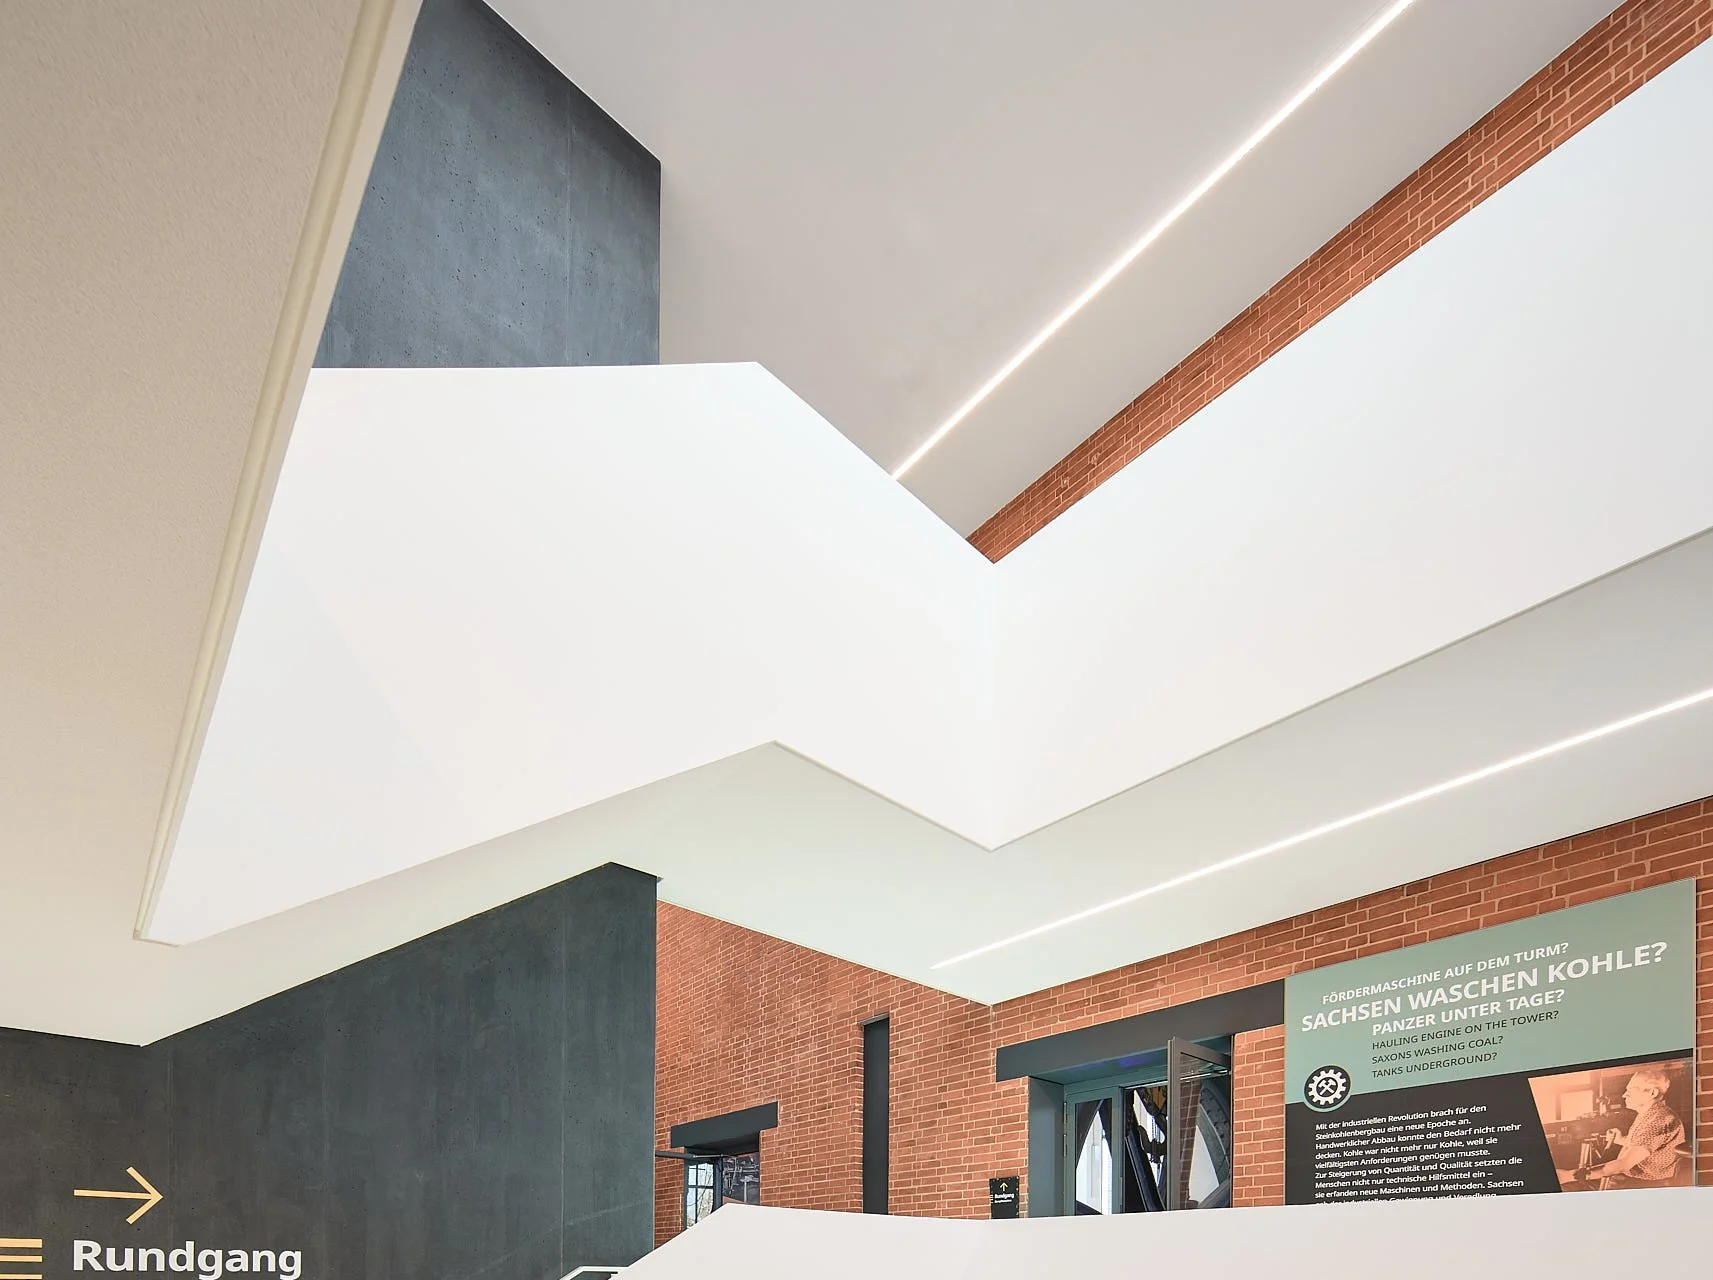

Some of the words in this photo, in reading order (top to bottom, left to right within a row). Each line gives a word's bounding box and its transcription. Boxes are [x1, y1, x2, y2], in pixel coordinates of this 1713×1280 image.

[1301, 996, 1401, 1032] SACHSEN
[1408, 967, 1538, 1011] WASCHEN
[1548, 941, 1668, 983] KOHLE?
[1322, 970, 1441, 1005] FÖRDERMASCHINE
[1444, 963, 1473, 979] AUF
[1477, 955, 1510, 972] DEM
[1514, 942, 1569, 963] TURM?
[1372, 1013, 1436, 1036] PANZER
[1441, 1001, 1501, 1023] UNTER
[1506, 989, 1565, 1011] TAGE?
[1372, 1035, 1418, 1050] HAULING
[1421, 1027, 1462, 1042] ENGINE
[1464, 1024, 1482, 1034] ON
[1485, 1019, 1507, 1031] THE
[1510, 1010, 1559, 1026] TOWER?
[1372, 1051, 1412, 1064] SAXONS
[1414, 1043, 1465, 1057] WASHING
[1468, 1035, 1504, 1048] COAL?
[1372, 1067, 1403, 1078] TANKS
[1406, 1052, 1497, 1073] UNDERGROUND?
[1388, 1112, 1428, 1122] Revolution
[1431, 1108, 1454, 1117] brach
[1455, 1107, 1468, 1115] für
[1470, 1105, 1487, 1113] den
[1315, 1128, 1386, 1140] Steinkohlenbergbau
[1405, 1123, 1425, 1131] neue
[1427, 1119, 1457, 1129] Epoche
[1315, 1140, 1370, 1150] Handwerklicher
[1371, 1136, 1396, 1144] Abbau
[1397, 1133, 1424, 1142] konnte
[1426, 1131, 1441, 1139] den
[1444, 1128, 1472, 1137] Bedarf
[1474, 1126, 1495, 1134] nicht
[1496, 1123, 1522, 1132] mehr
[1315, 1151, 1341, 1160] decken.
[1343, 1149, 1363, 1157] Kohle
[1380, 1146, 1399, 1154] nicht
[1400, 1144, 1422, 1152] mehr
[1439, 1141, 1464, 1149] Kohle,
[1466, 1138, 1483, 1146] weil
[1315, 1160, 1359, 1169] vielfältigsten
[1360, 1154, 1417, 1165] Anforderungen
[1419, 1151, 1455, 1162] genügen
[1457, 1149, 1490, 1157] musste.
[1315, 1180, 1350, 1189] Menschen
[1386, 1174, 1427, 1184] technische
[1428, 1171, 1470, 1181] Hilfsmittel
[1472, 1170, 1485, 1178] ein
[1328, 1169, 1366, 1178] Steigerung
[1383, 1165, 1420, 1174] Quantität
[1422, 1163, 1437, 1171] und
[1439, 1161, 1472, 1170] Qualität
[1474, 1158, 1506, 1167] setzten
[1508, 1156, 1522, 1165] die
[1326, 1189, 1358, 1198] erfanden
[1379, 1186, 1420, 1195] Maschinen
[1422, 1184, 1438, 1192] und
[1440, 1182, 1485, 1191] Methoden.
[1487, 1180, 1524, 1188] Sachsen
[72, 1239, 302, 1280] Rundgang
